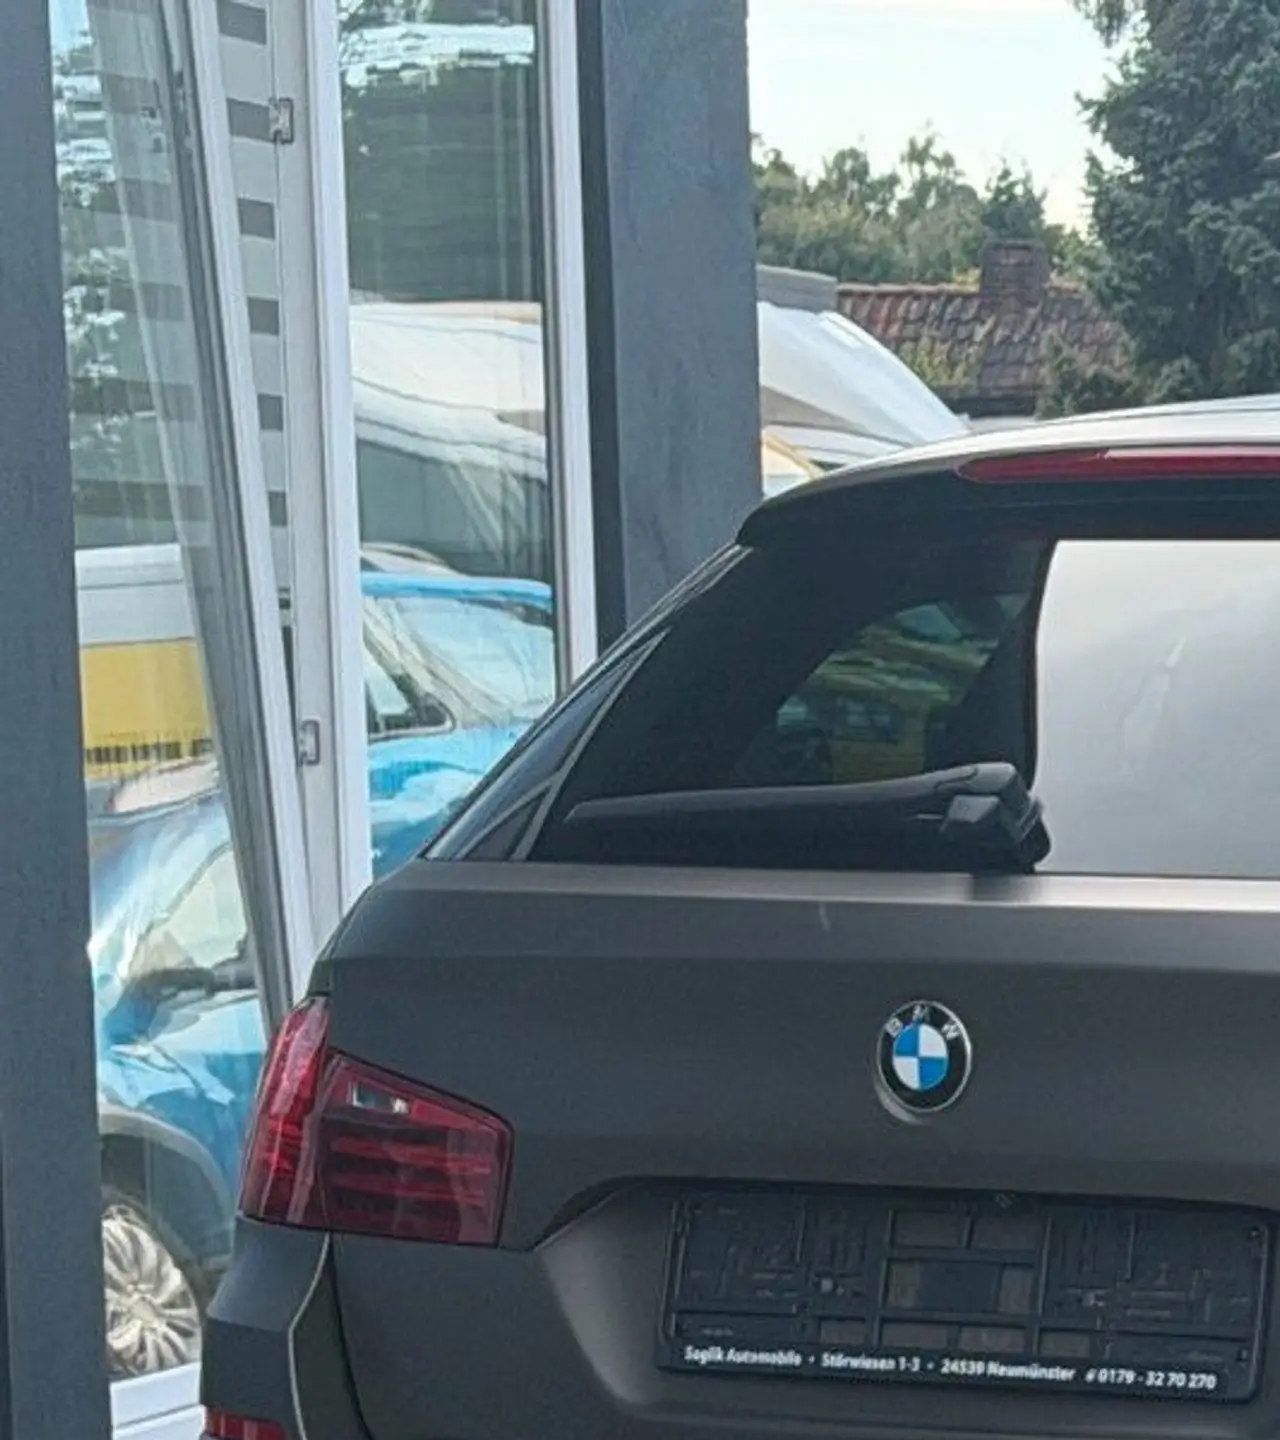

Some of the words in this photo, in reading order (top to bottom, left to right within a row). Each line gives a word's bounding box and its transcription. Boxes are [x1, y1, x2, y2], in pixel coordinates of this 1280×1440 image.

[727, 1347, 802, 1367] Automobile
[898, 1355, 920, 1372] 1-3
[940, 1358, 984, 1375] 24539
[986, 1360, 1076, 1381] Neumünster
[1098, 1368, 1136, 1385] 0179
[1145, 1370, 1165, 1386] 32
[1167, 1371, 1187, 1388] 70
[1188, 1373, 1218, 1390] 270
